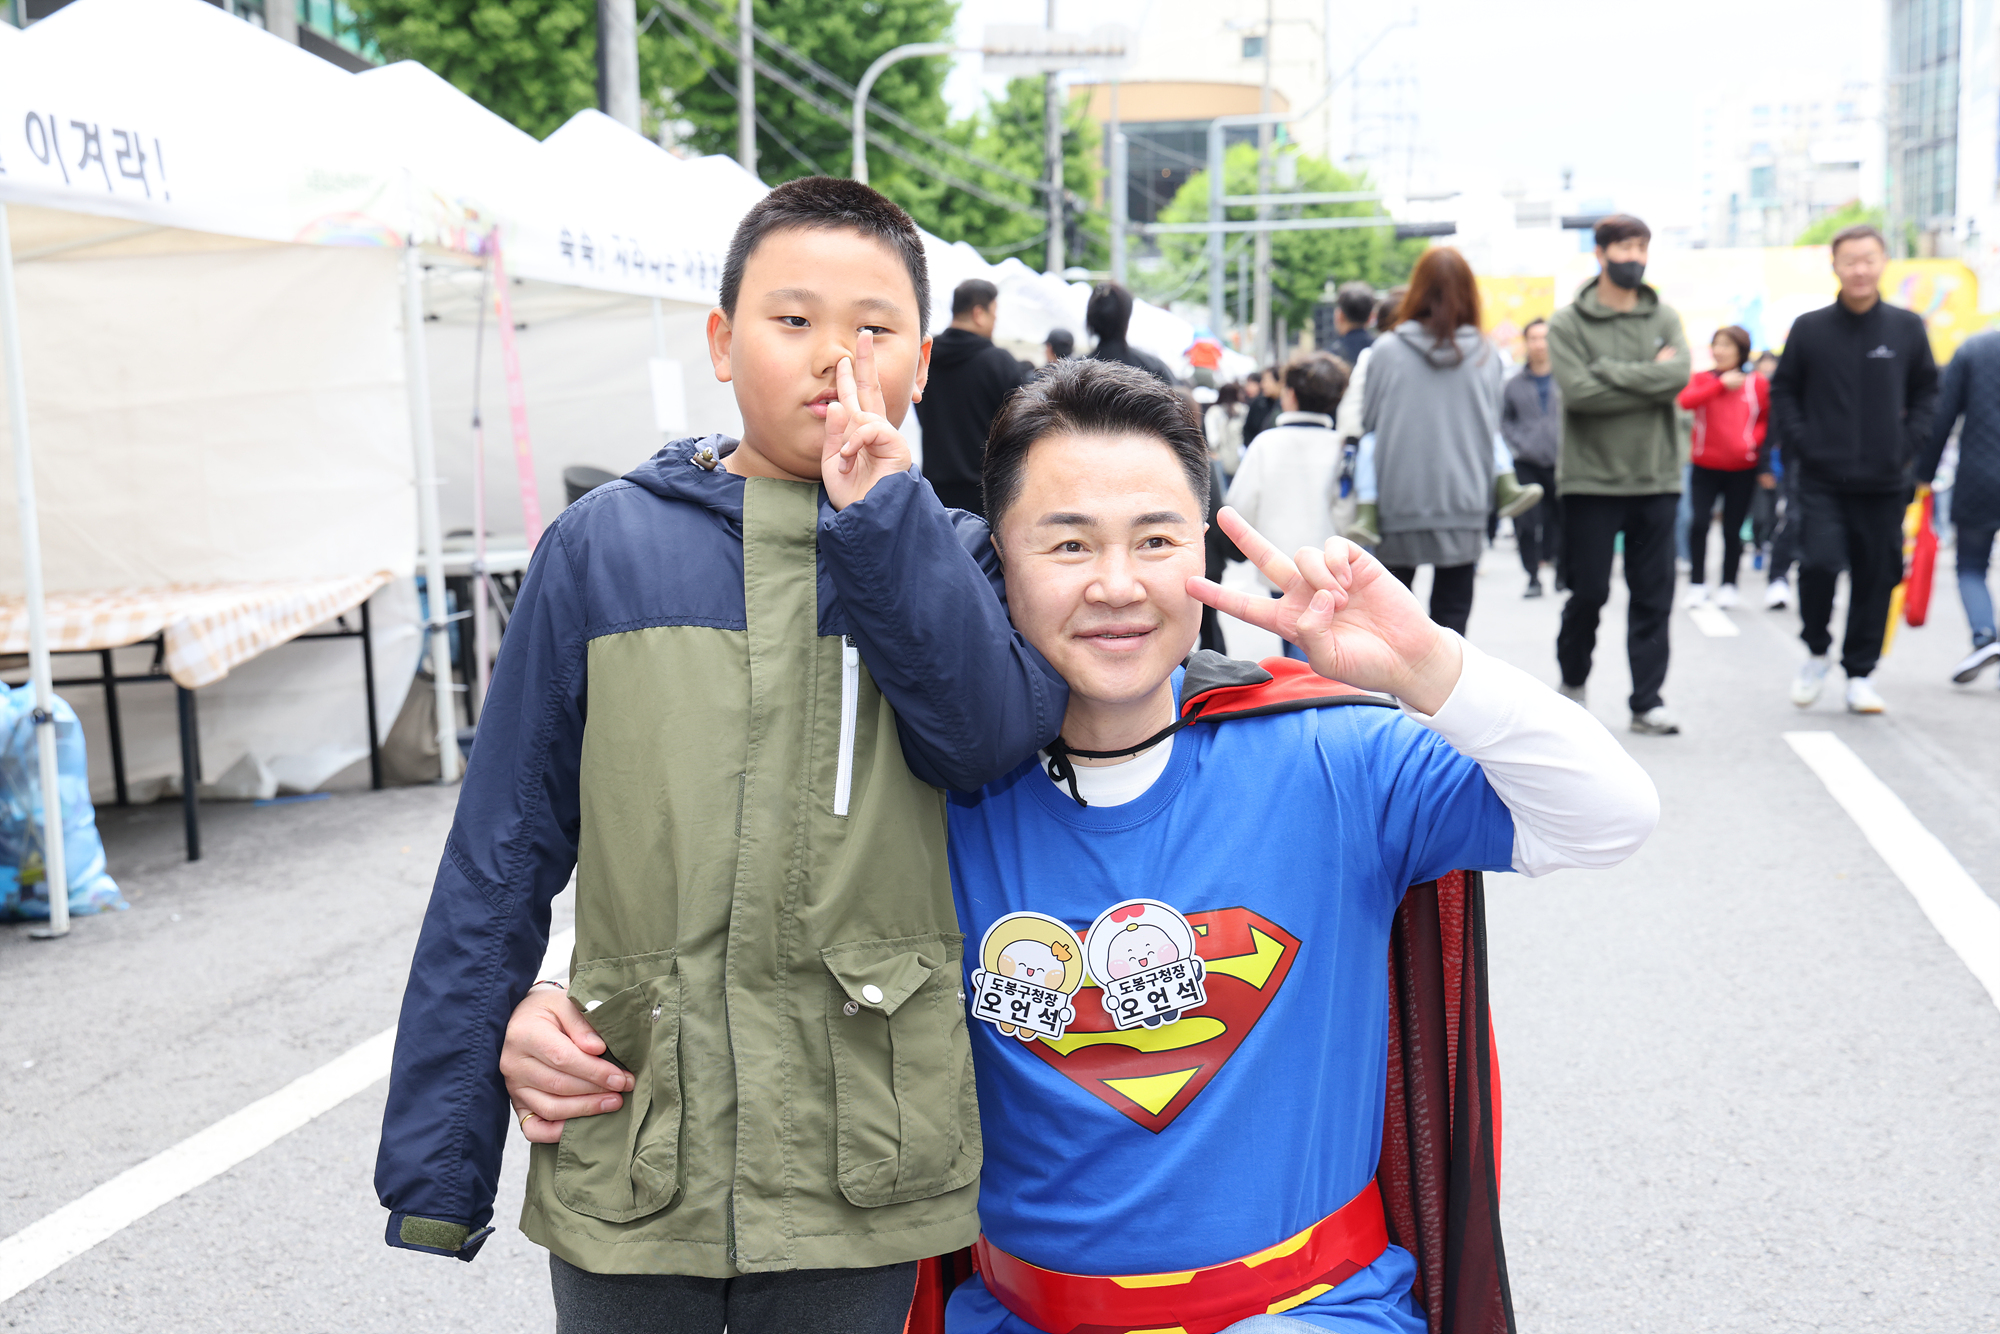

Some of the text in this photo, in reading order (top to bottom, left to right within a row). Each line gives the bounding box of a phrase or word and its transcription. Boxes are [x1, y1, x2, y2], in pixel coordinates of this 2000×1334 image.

[25, 111, 170, 201] 이겨라!
[990, 977, 1059, 1008] 도봉구청장
[1119, 963, 1186, 996] 도봉구청장
